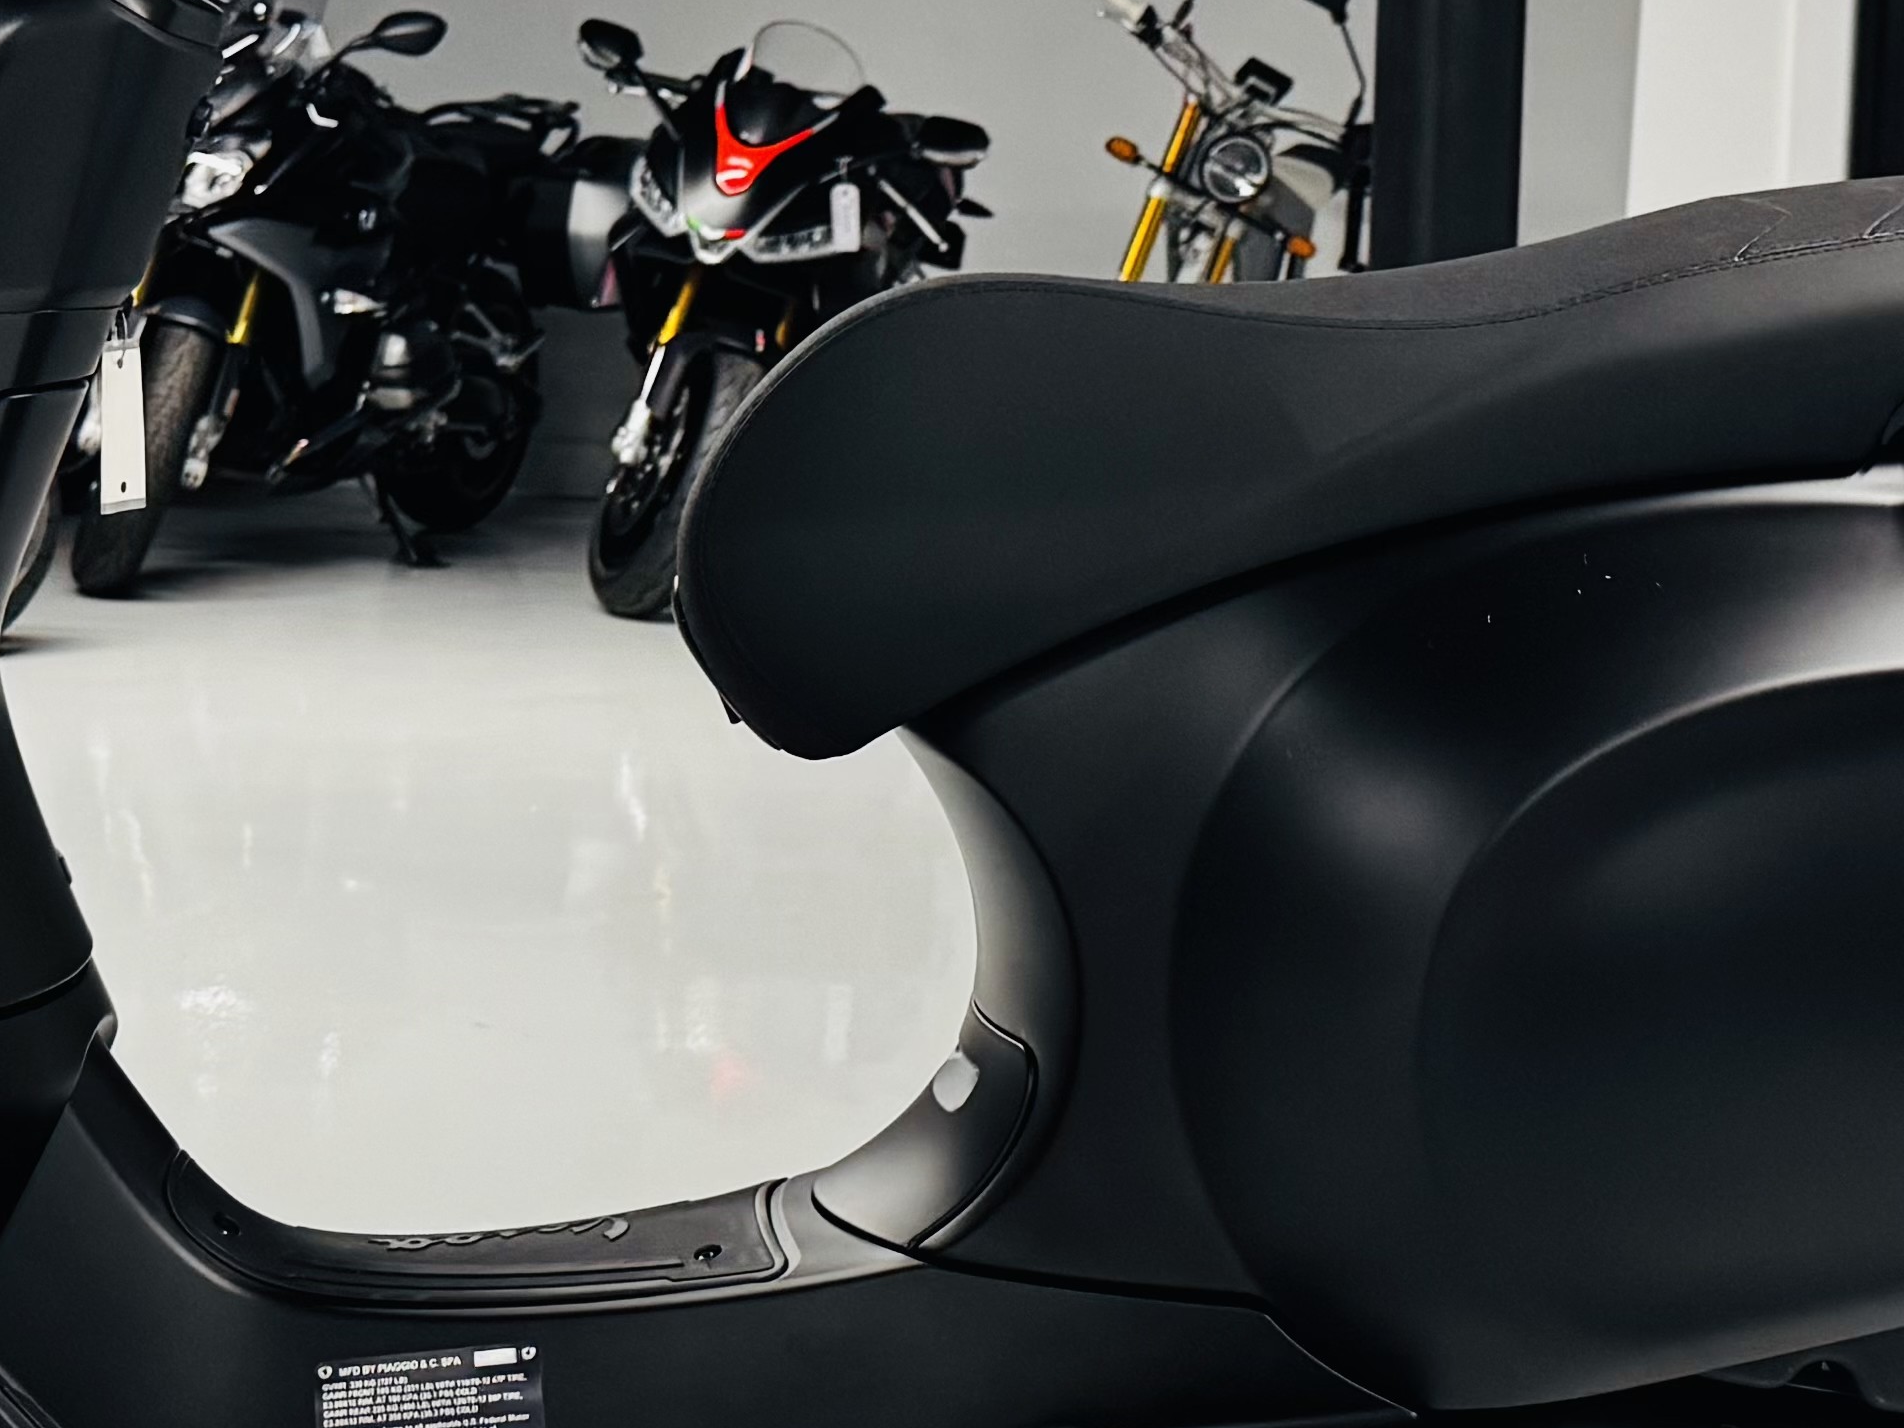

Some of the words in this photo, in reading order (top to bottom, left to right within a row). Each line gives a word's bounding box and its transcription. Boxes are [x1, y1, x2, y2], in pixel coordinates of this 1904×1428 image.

[361, 1364, 376, 1376] BY
[377, 1360, 419, 1373] PIAGGIO
[420, 1359, 428, 1369] &
